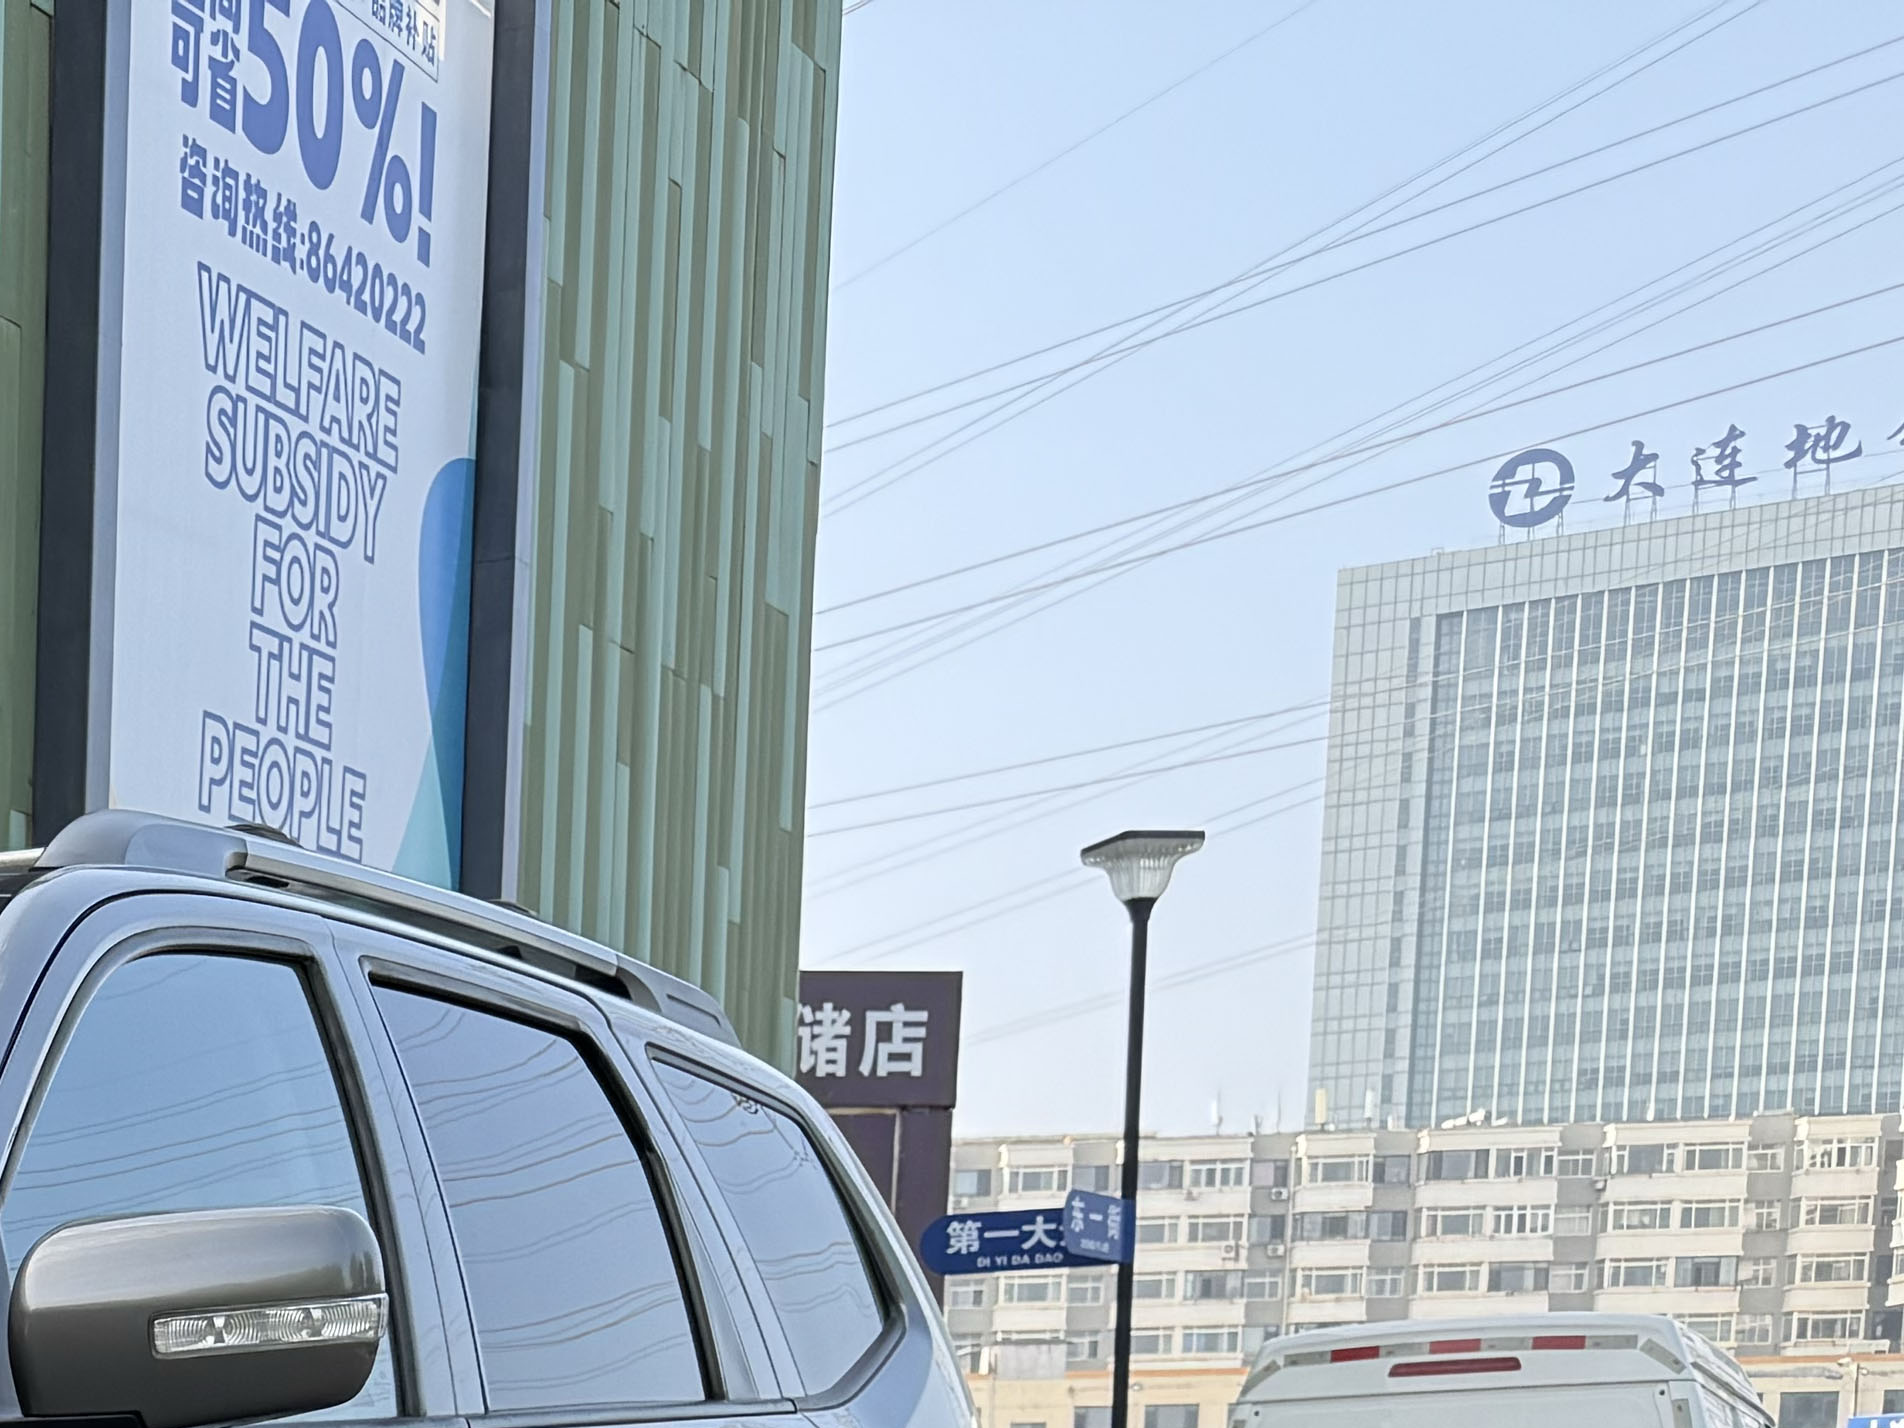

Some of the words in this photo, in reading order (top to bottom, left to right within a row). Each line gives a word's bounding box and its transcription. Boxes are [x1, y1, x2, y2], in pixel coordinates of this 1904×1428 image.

[197, 260, 401, 474] WELFARE
[205, 385, 387, 564] SUBSIDY
[1604, 415, 1904, 502] 大连地
[251, 513, 339, 649] FOR
[249, 620, 336, 752] THE
[198, 710, 367, 864] PEOPLE
[946, 1215, 1065, 1255] 第一大
[976, 1256, 991, 1268] DI
[995, 1255, 1008, 1266] YI
